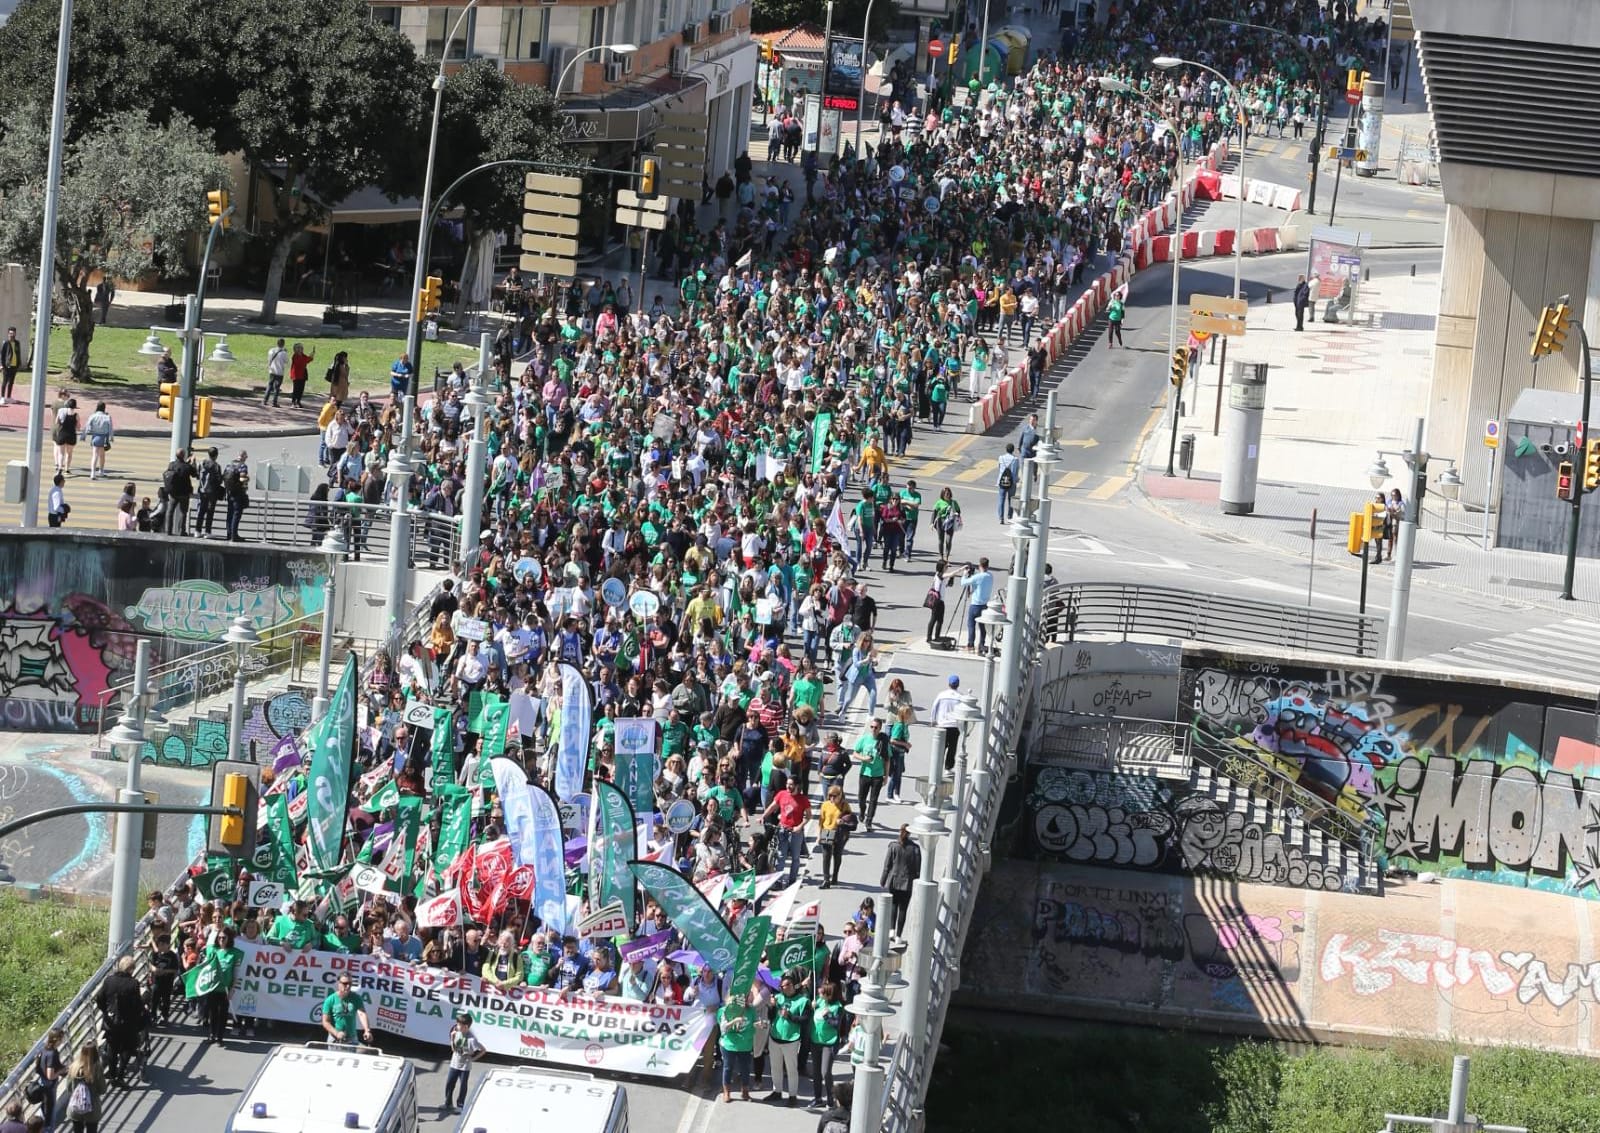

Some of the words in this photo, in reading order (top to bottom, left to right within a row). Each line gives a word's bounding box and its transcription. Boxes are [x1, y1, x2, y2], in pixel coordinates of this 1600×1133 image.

[246, 965, 277, 979] NO
[284, 969, 314, 983] AL
[322, 971, 404, 994] CERRE
[412, 985, 441, 1001] DE
[448, 991, 564, 1022] UNIDADES
[255, 951, 286, 965] NO
[293, 956, 322, 968] AL
[331, 957, 435, 986] DECRETO
[443, 976, 472, 991] DE
[234, 978, 259, 993] EN
[380, 994, 408, 1011] DE
[416, 1001, 443, 1018] LA
[451, 1007, 590, 1042] ENSEÑANZA
